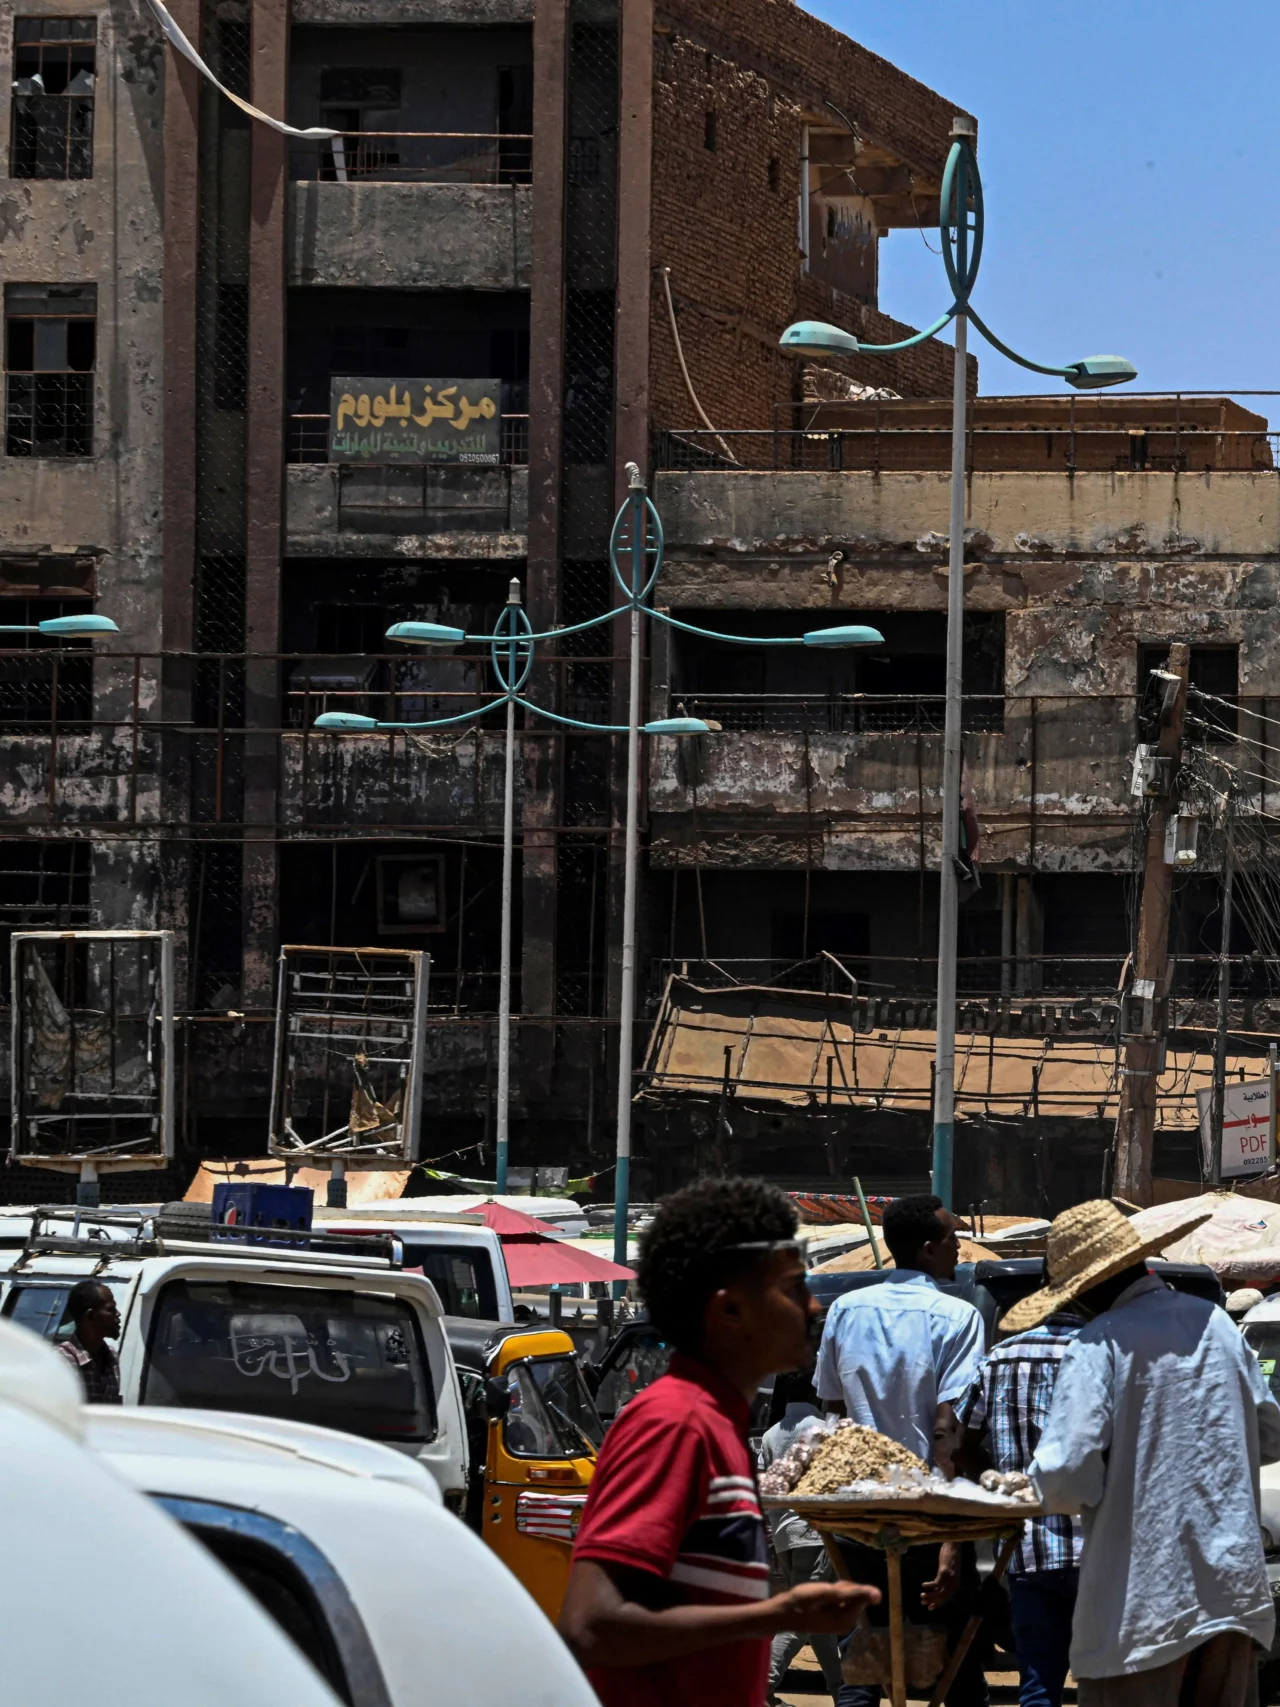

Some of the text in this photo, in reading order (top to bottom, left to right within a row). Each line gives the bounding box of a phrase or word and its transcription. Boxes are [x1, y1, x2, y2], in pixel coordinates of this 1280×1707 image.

[336, 384, 497, 431] مركز بلووم
[1240, 1134, 1267, 1154] PDF
[1243, 1156, 1270, 1165] 092285
